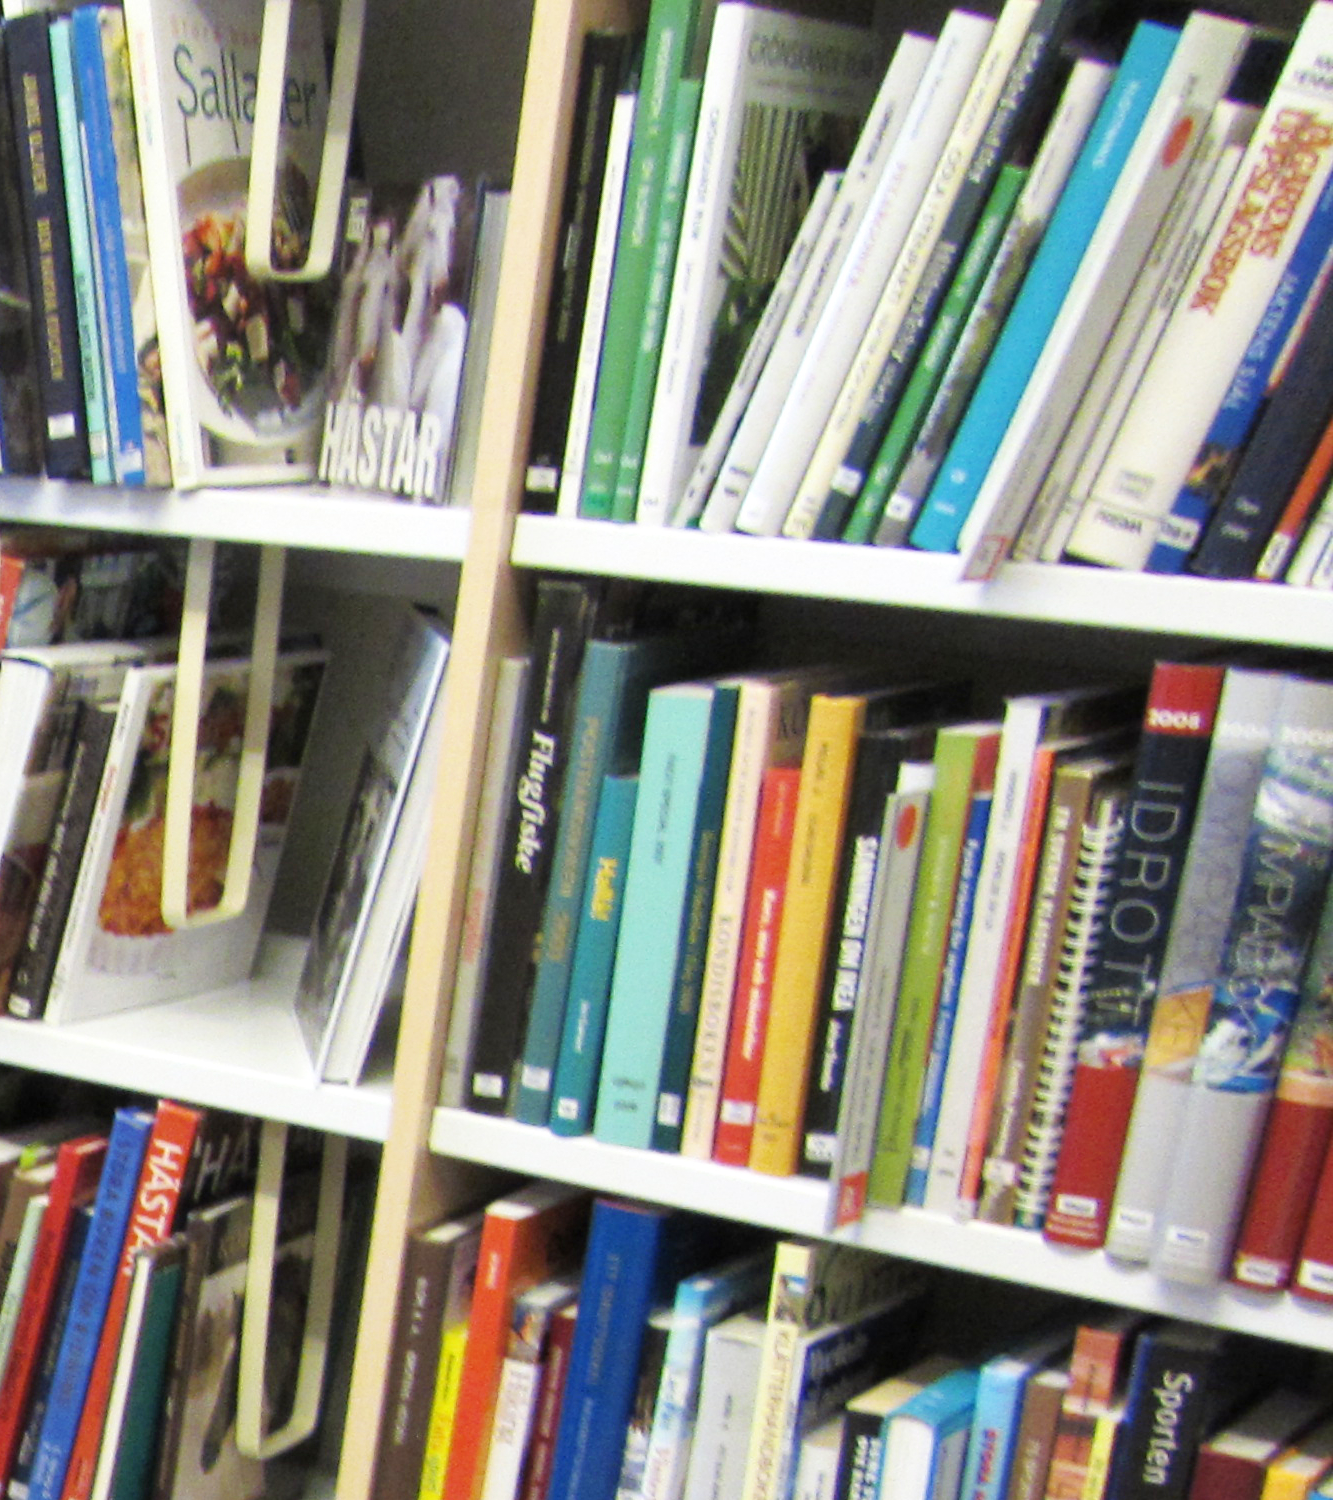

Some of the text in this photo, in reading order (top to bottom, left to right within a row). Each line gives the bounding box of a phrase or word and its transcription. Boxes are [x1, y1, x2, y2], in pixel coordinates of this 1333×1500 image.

[173, 43, 317, 145] Sallaer
[514, 729, 557, 875] Flugfiske
[1095, 780, 1185, 1027] IDROTT
[1142, 1370, 1194, 1486] Sporten
